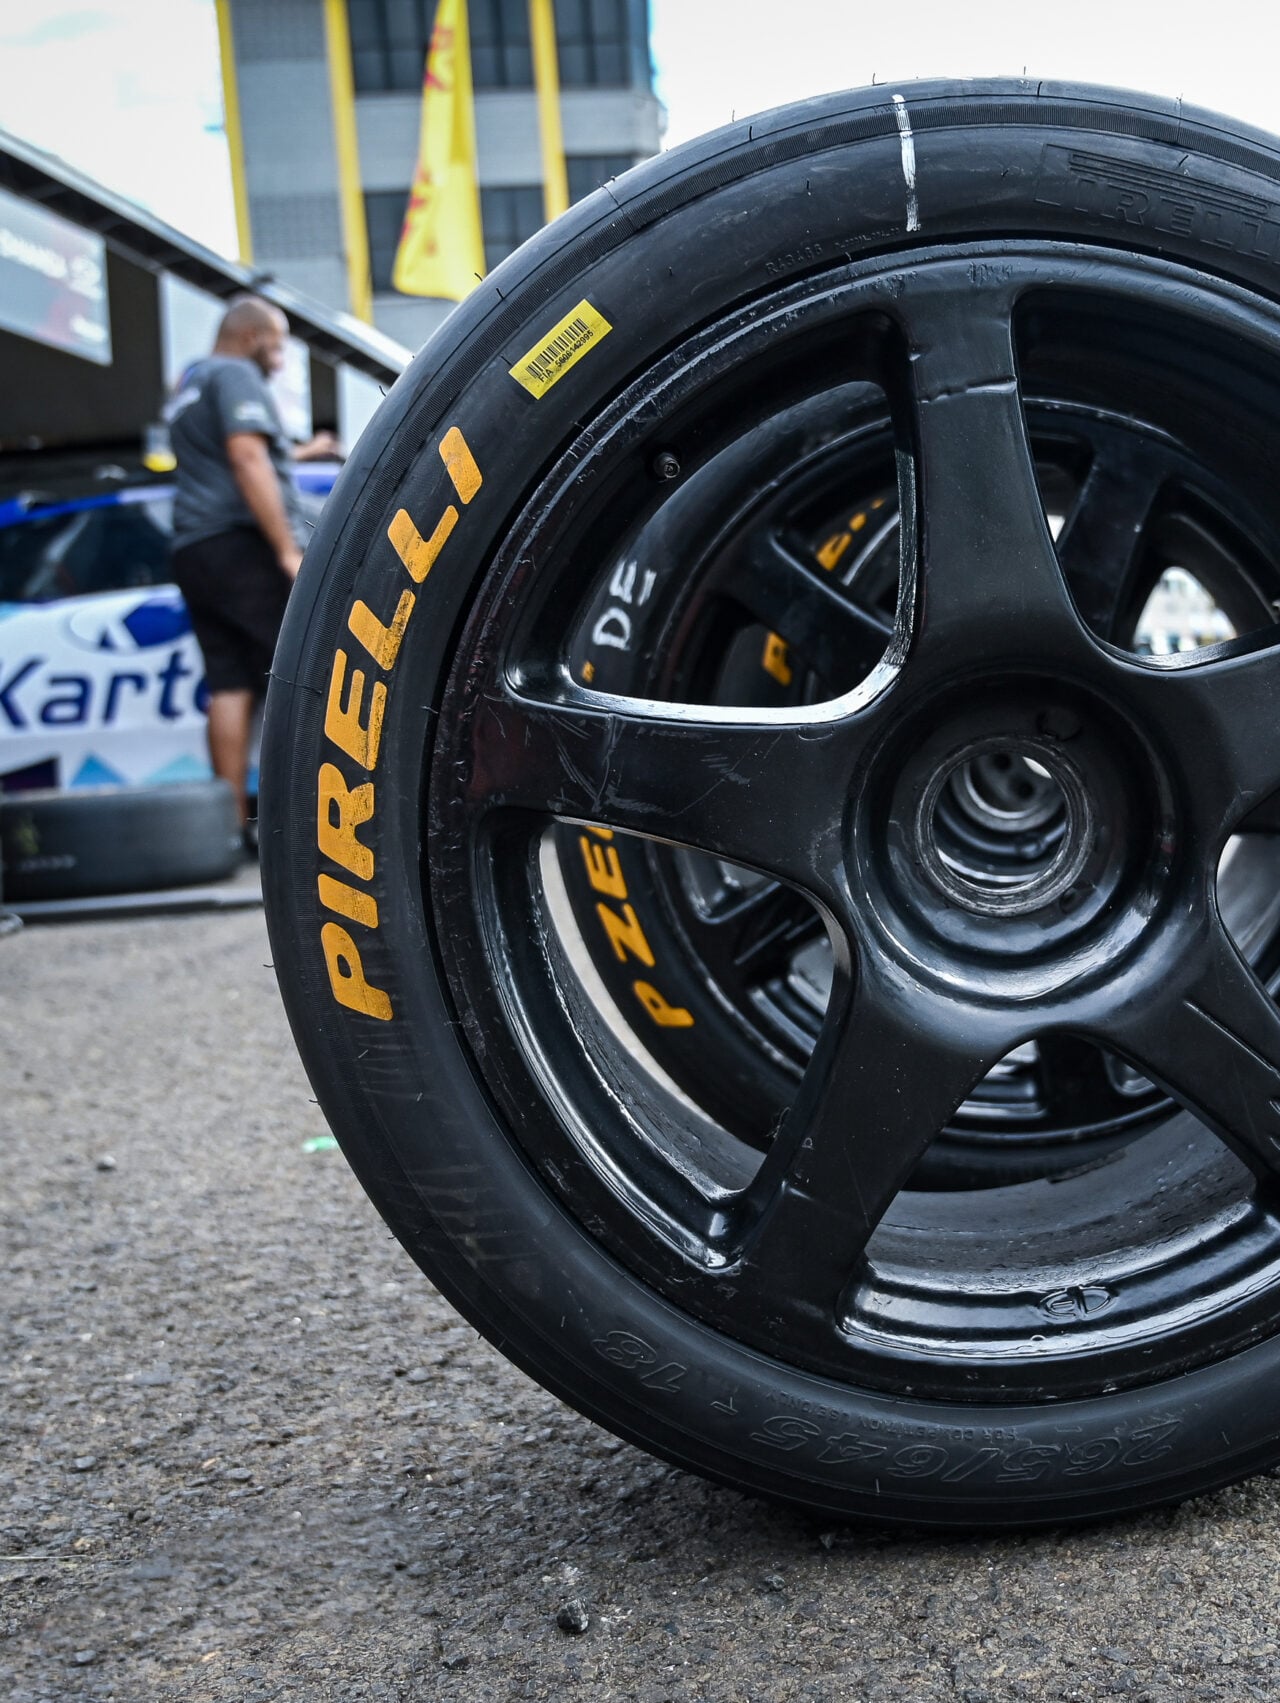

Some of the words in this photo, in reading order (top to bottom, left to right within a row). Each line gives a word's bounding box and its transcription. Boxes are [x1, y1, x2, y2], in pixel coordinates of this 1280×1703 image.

[537, 362, 555, 384] FIA
[317, 426, 485, 1023] PIRELLI
[749, 1414, 1184, 1484] 265/645
